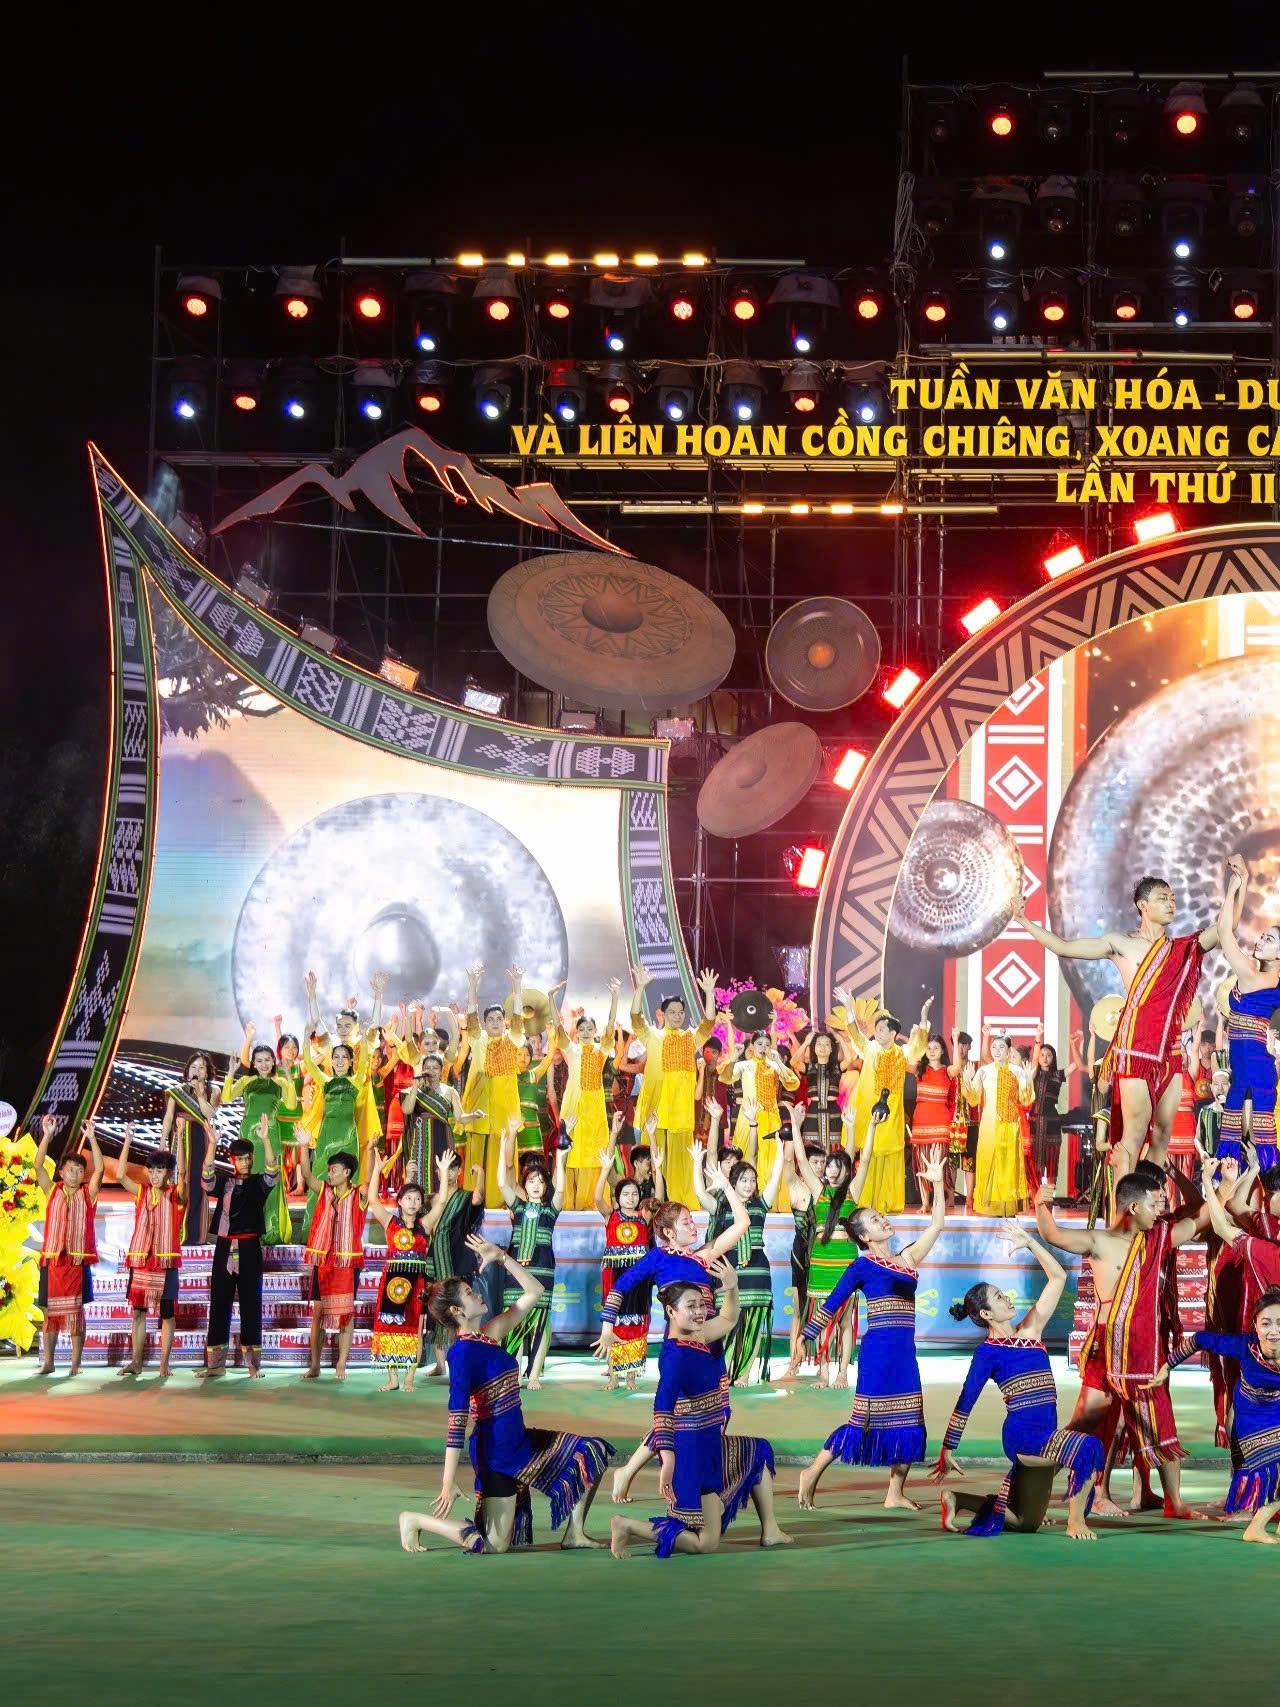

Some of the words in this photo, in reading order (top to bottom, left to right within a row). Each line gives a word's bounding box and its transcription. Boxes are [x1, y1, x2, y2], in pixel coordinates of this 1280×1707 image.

[890, 362, 1001, 410] TUẦN
[1015, 370, 1096, 410] VĂN
[1115, 367, 1202, 410] HÓA
[1215, 392, 1226, 401] -
[511, 413, 564, 457] VÀ
[578, 414, 664, 457] LIÊN
[676, 424, 787, 457] HOAN
[801, 407, 909, 457] CỒNG
[923, 416, 1083, 461] CHIÊNG,
[1096, 425, 1230, 457] XOANG
[1055, 455, 1136, 504] LẦN
[1150, 462, 1237, 504] THỨ
[1250, 473, 1276, 504] II
